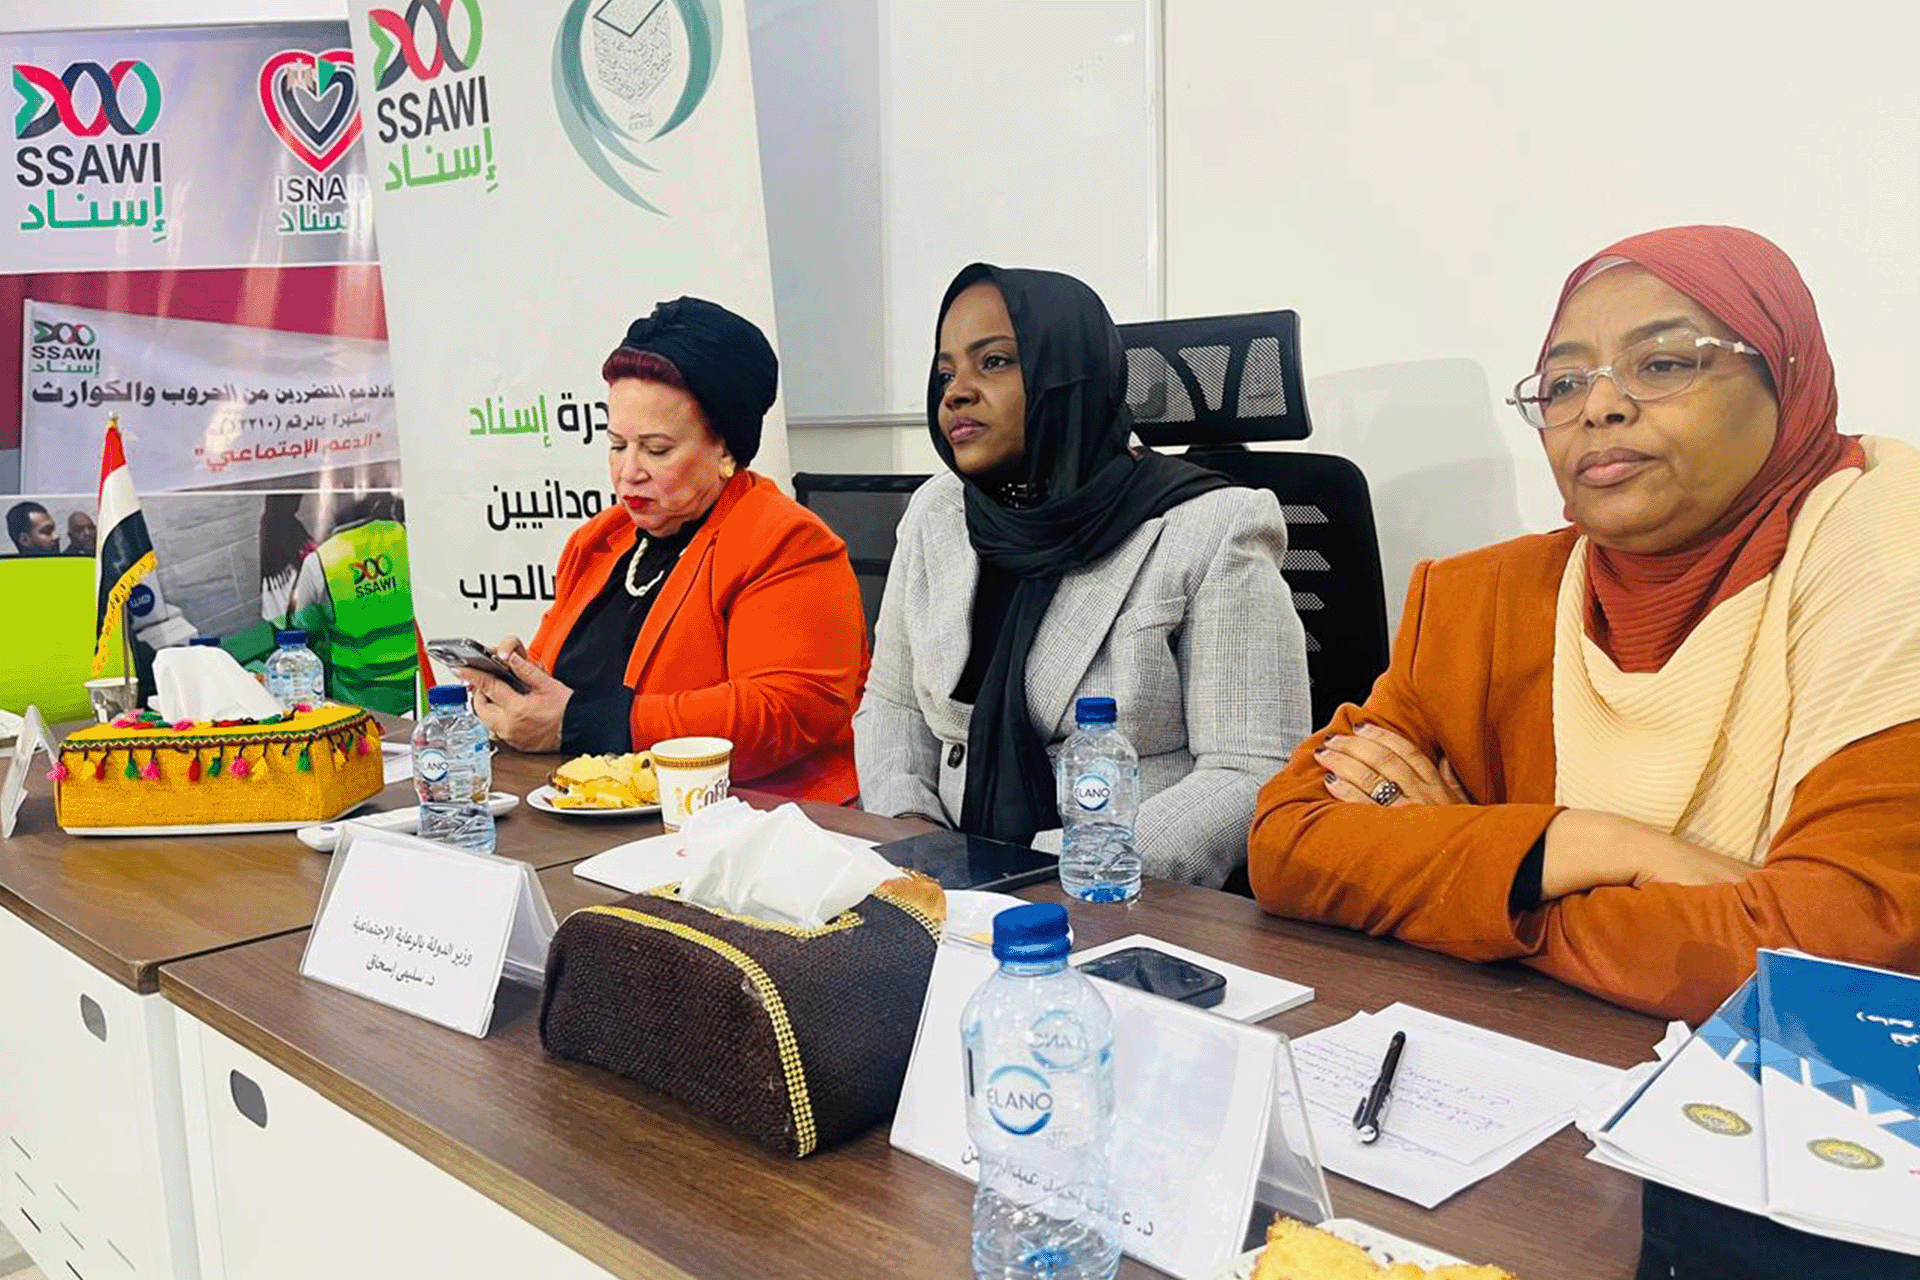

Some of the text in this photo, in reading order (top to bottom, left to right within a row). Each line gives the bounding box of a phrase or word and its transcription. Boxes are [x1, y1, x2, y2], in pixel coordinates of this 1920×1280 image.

[377, 75, 490, 144] SSAWI
[16, 142, 162, 187] SSAWI
[384, 127, 498, 193] إسناد
[278, 176, 360, 203] ISNA
[20, 184, 167, 243] إسناد
[278, 203, 352, 234] سناد
[31, 345, 101, 361] SSAWI
[31, 359, 101, 378] إسناد
[31, 379, 156, 408] والكوارث
[161, 382, 238, 407] الحروب
[243, 386, 270, 406] من
[275, 383, 347, 404] المتضررين
[469, 392, 610, 448] درة إسناد
[486, 479, 617, 531] ودانيين
[355, 575, 397, 599] SSAWI
[427, 935, 453, 957] الدولة
[451, 948, 472, 967] وزير
[986, 1087, 1054, 1112] ELANO
[1136, 1221, 1155, 1237] د.
